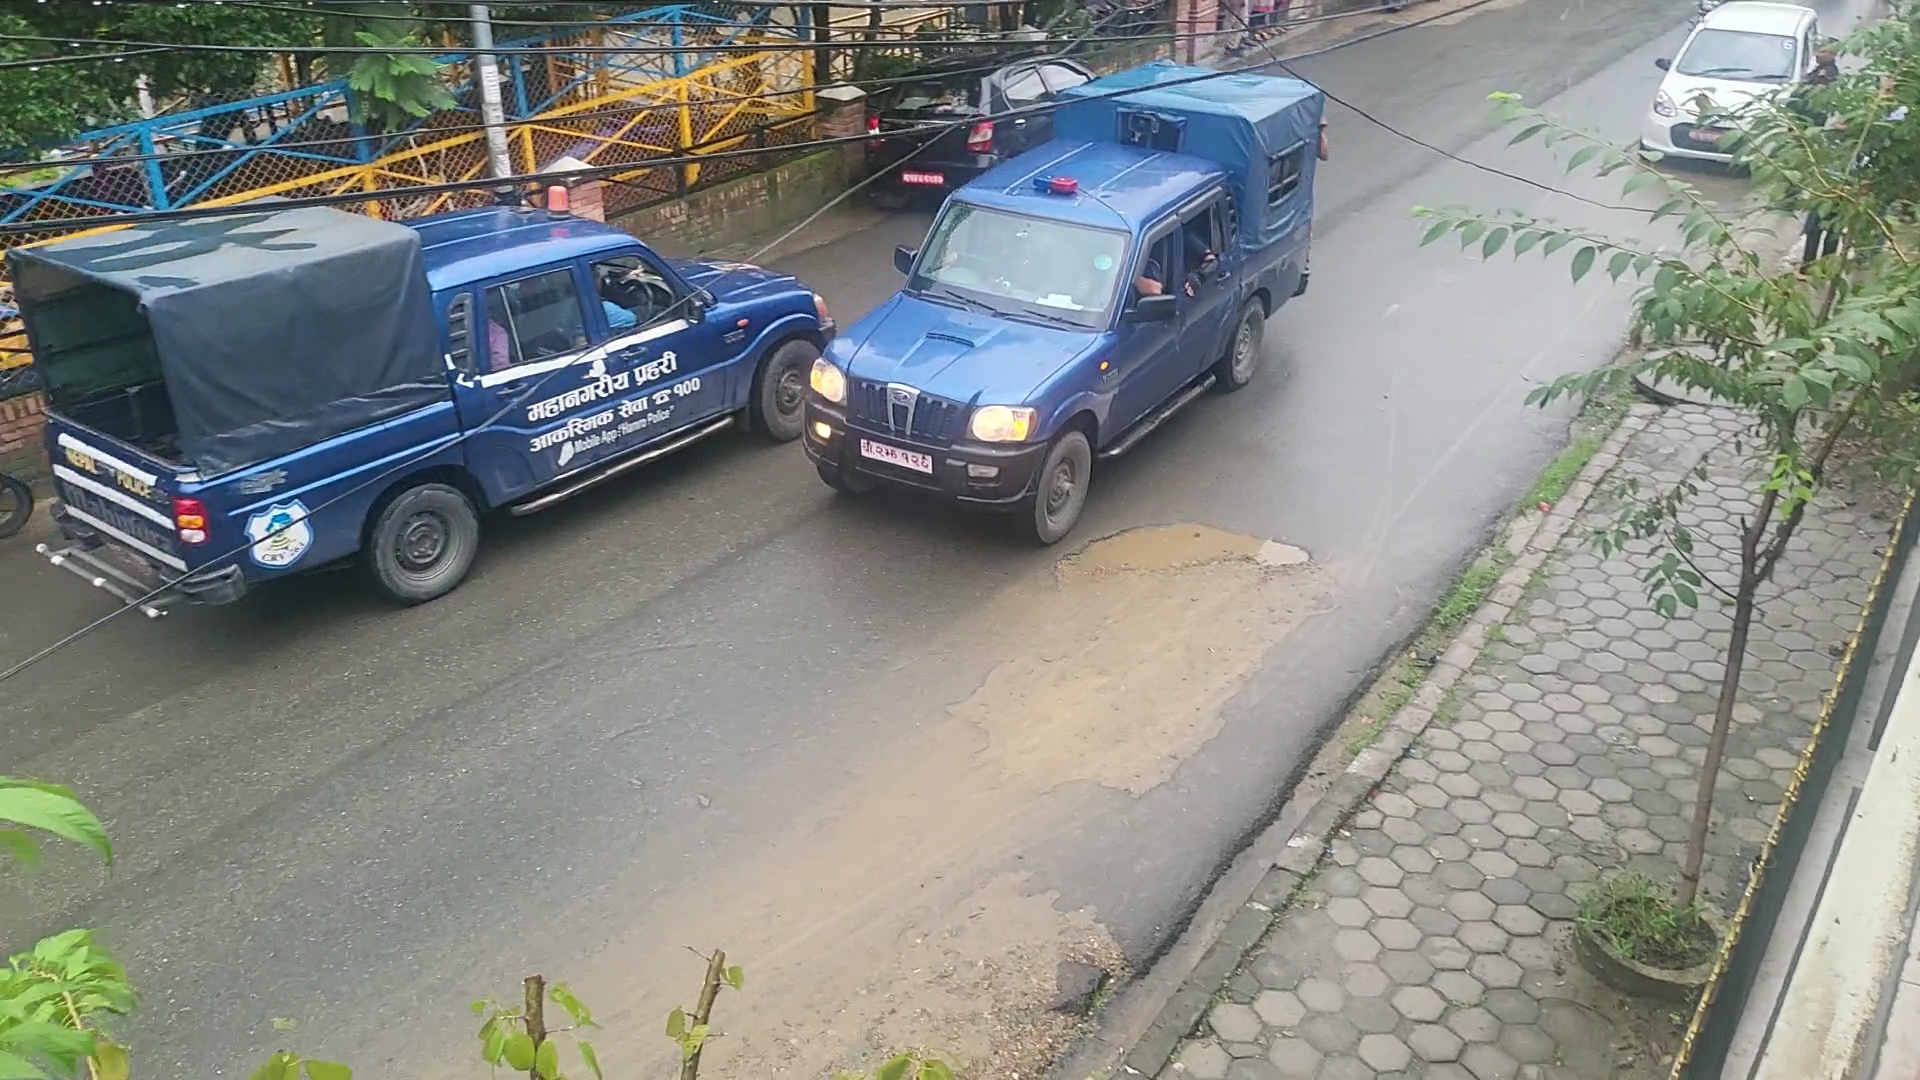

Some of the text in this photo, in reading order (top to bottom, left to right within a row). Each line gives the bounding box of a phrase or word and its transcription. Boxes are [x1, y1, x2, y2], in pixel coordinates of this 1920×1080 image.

[527, 351, 678, 422] महानगरीय प्रहरी
[529, 408, 615, 452] आकस्मिक
[618, 396, 648, 418] सेवा
[574, 434, 600, 453] Mobile
